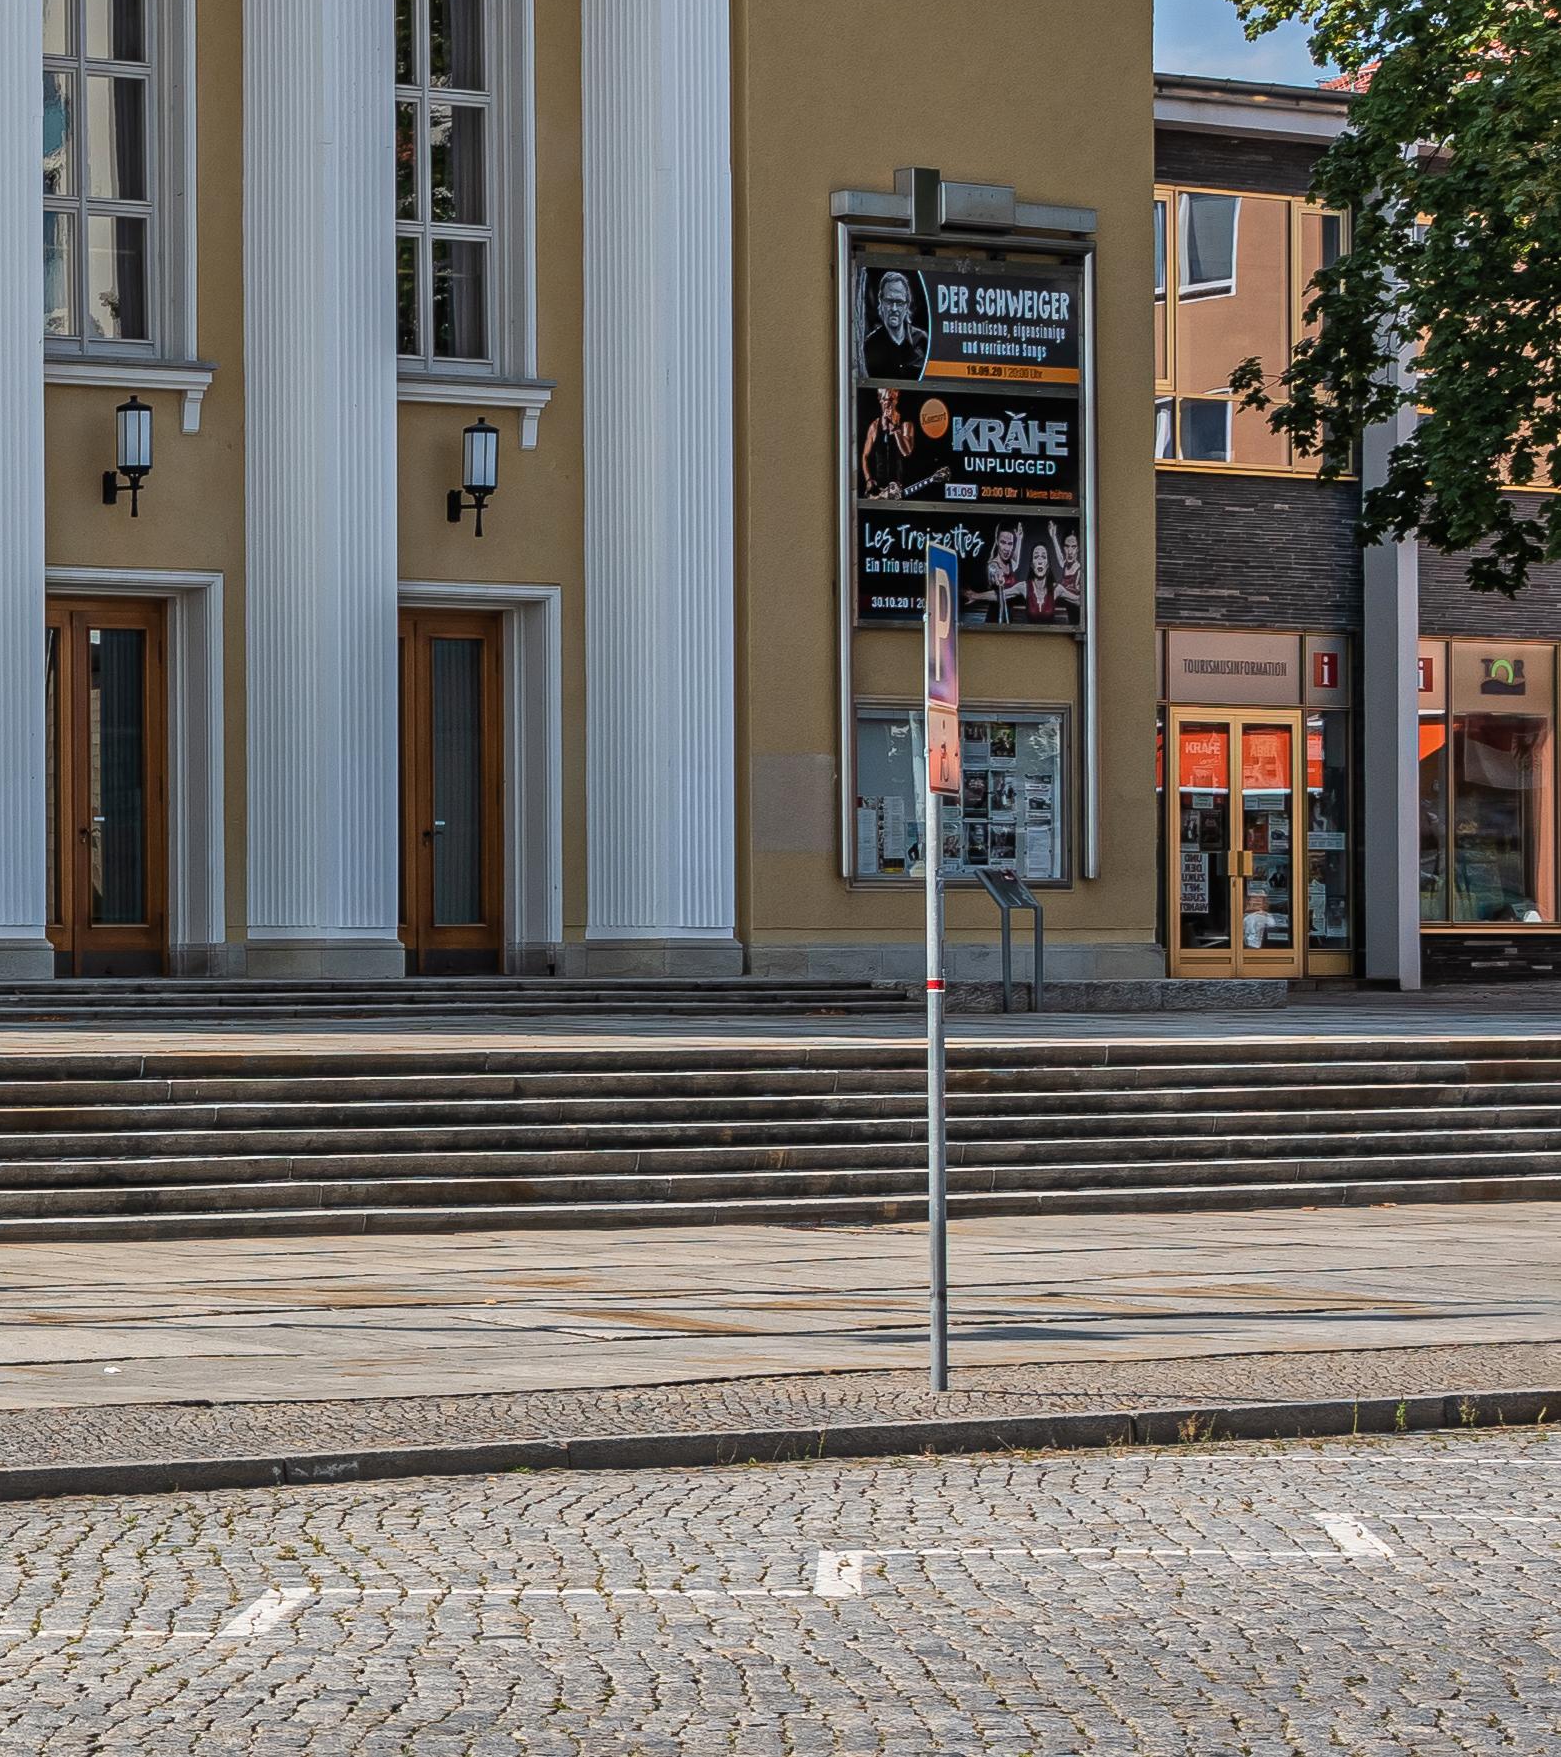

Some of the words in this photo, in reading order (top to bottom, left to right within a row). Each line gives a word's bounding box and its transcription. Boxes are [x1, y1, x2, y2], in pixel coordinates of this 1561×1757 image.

[937, 284, 969, 314] DER
[976, 287, 1070, 320] SCHWEIGER
[1013, 323, 1066, 343] eigensinnige
[962, 340, 977, 354] und
[980, 340, 1020, 356] verrückte
[1022, 343, 1047, 362] Songs
[964, 456, 1056, 475] UNPLUGGED
[865, 523, 895, 554] Les
[866, 557, 880, 572] Ein
[882, 557, 900, 572] Trio
[871, 596, 909, 608] 30.10.20
[935, 567, 951, 682] P
[1183, 658, 1287, 677] TOURISMUSINFORMATION
